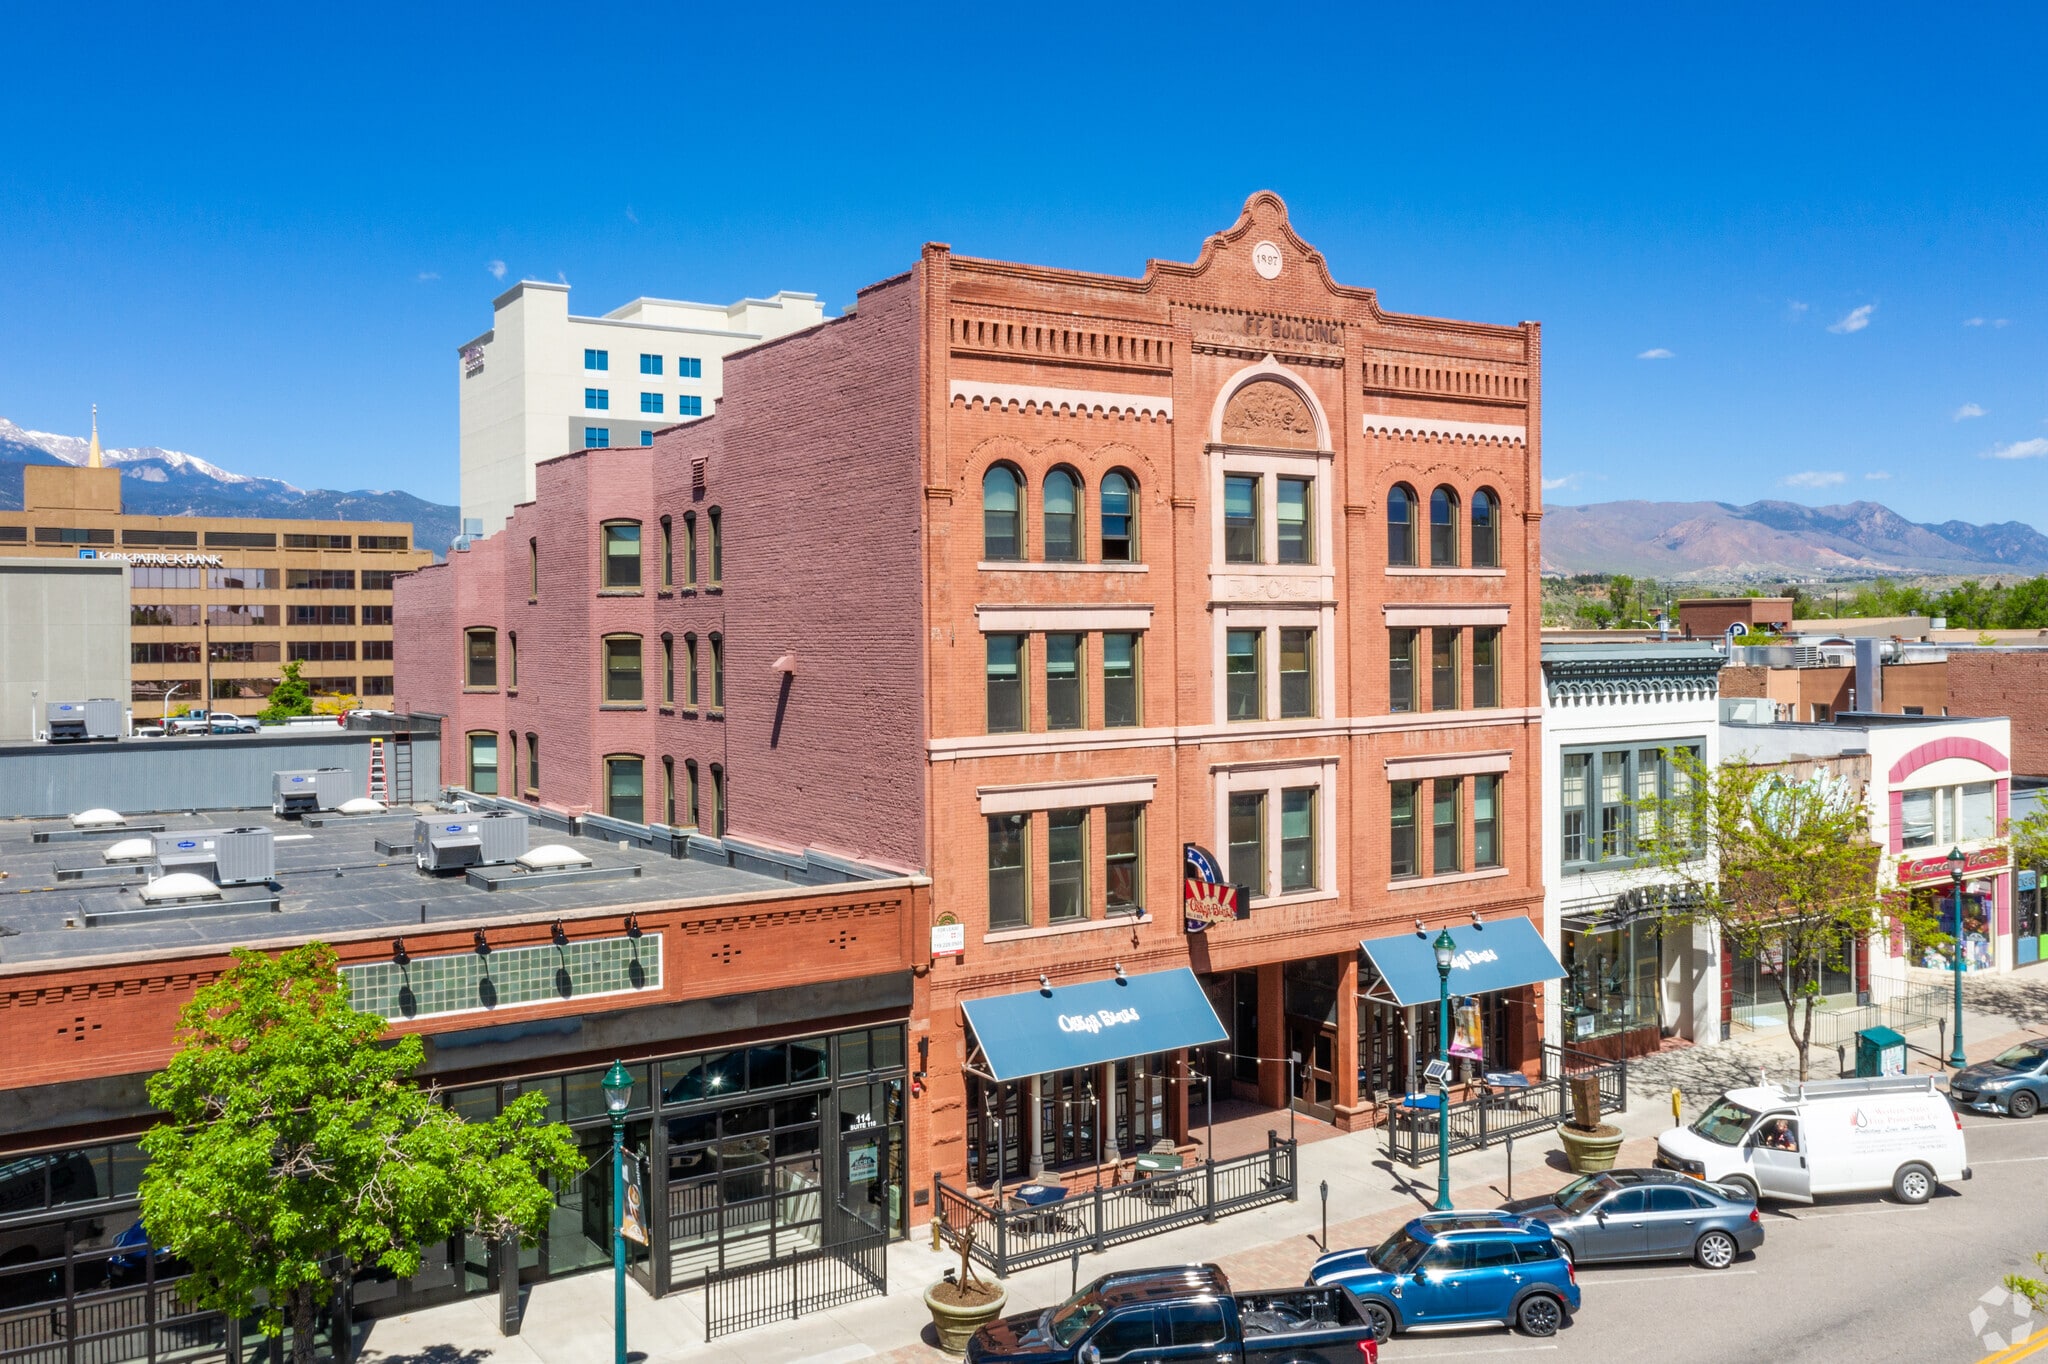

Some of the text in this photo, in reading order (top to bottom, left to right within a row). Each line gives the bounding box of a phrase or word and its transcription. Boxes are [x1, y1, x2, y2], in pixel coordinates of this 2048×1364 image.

[1257, 254, 1278, 266] 1897
[99, 551, 223, 564] KIRKPATRICK BANK
[1733, 625, 1743, 636] P
[856, 1113, 871, 1124] 114
